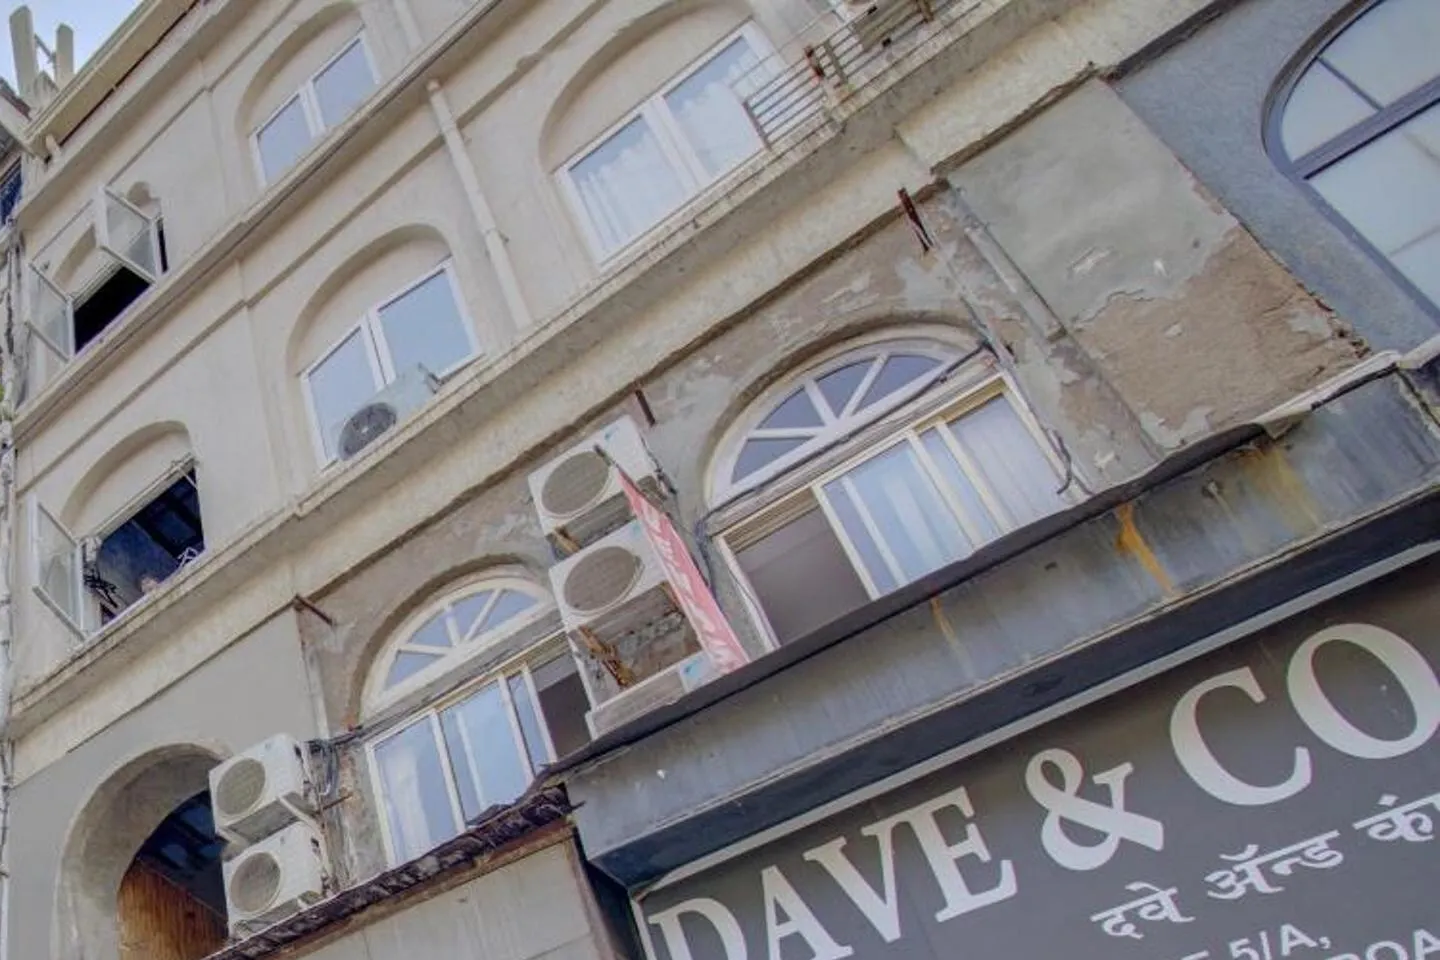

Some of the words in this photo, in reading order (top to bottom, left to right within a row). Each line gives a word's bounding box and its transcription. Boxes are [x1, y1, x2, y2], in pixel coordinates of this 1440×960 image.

[1026, 748, 1163, 870] &
[1171, 623, 1440, 805] CO
[1091, 881, 1196, 939] दवे
[1353, 794, 1440, 842] कं
